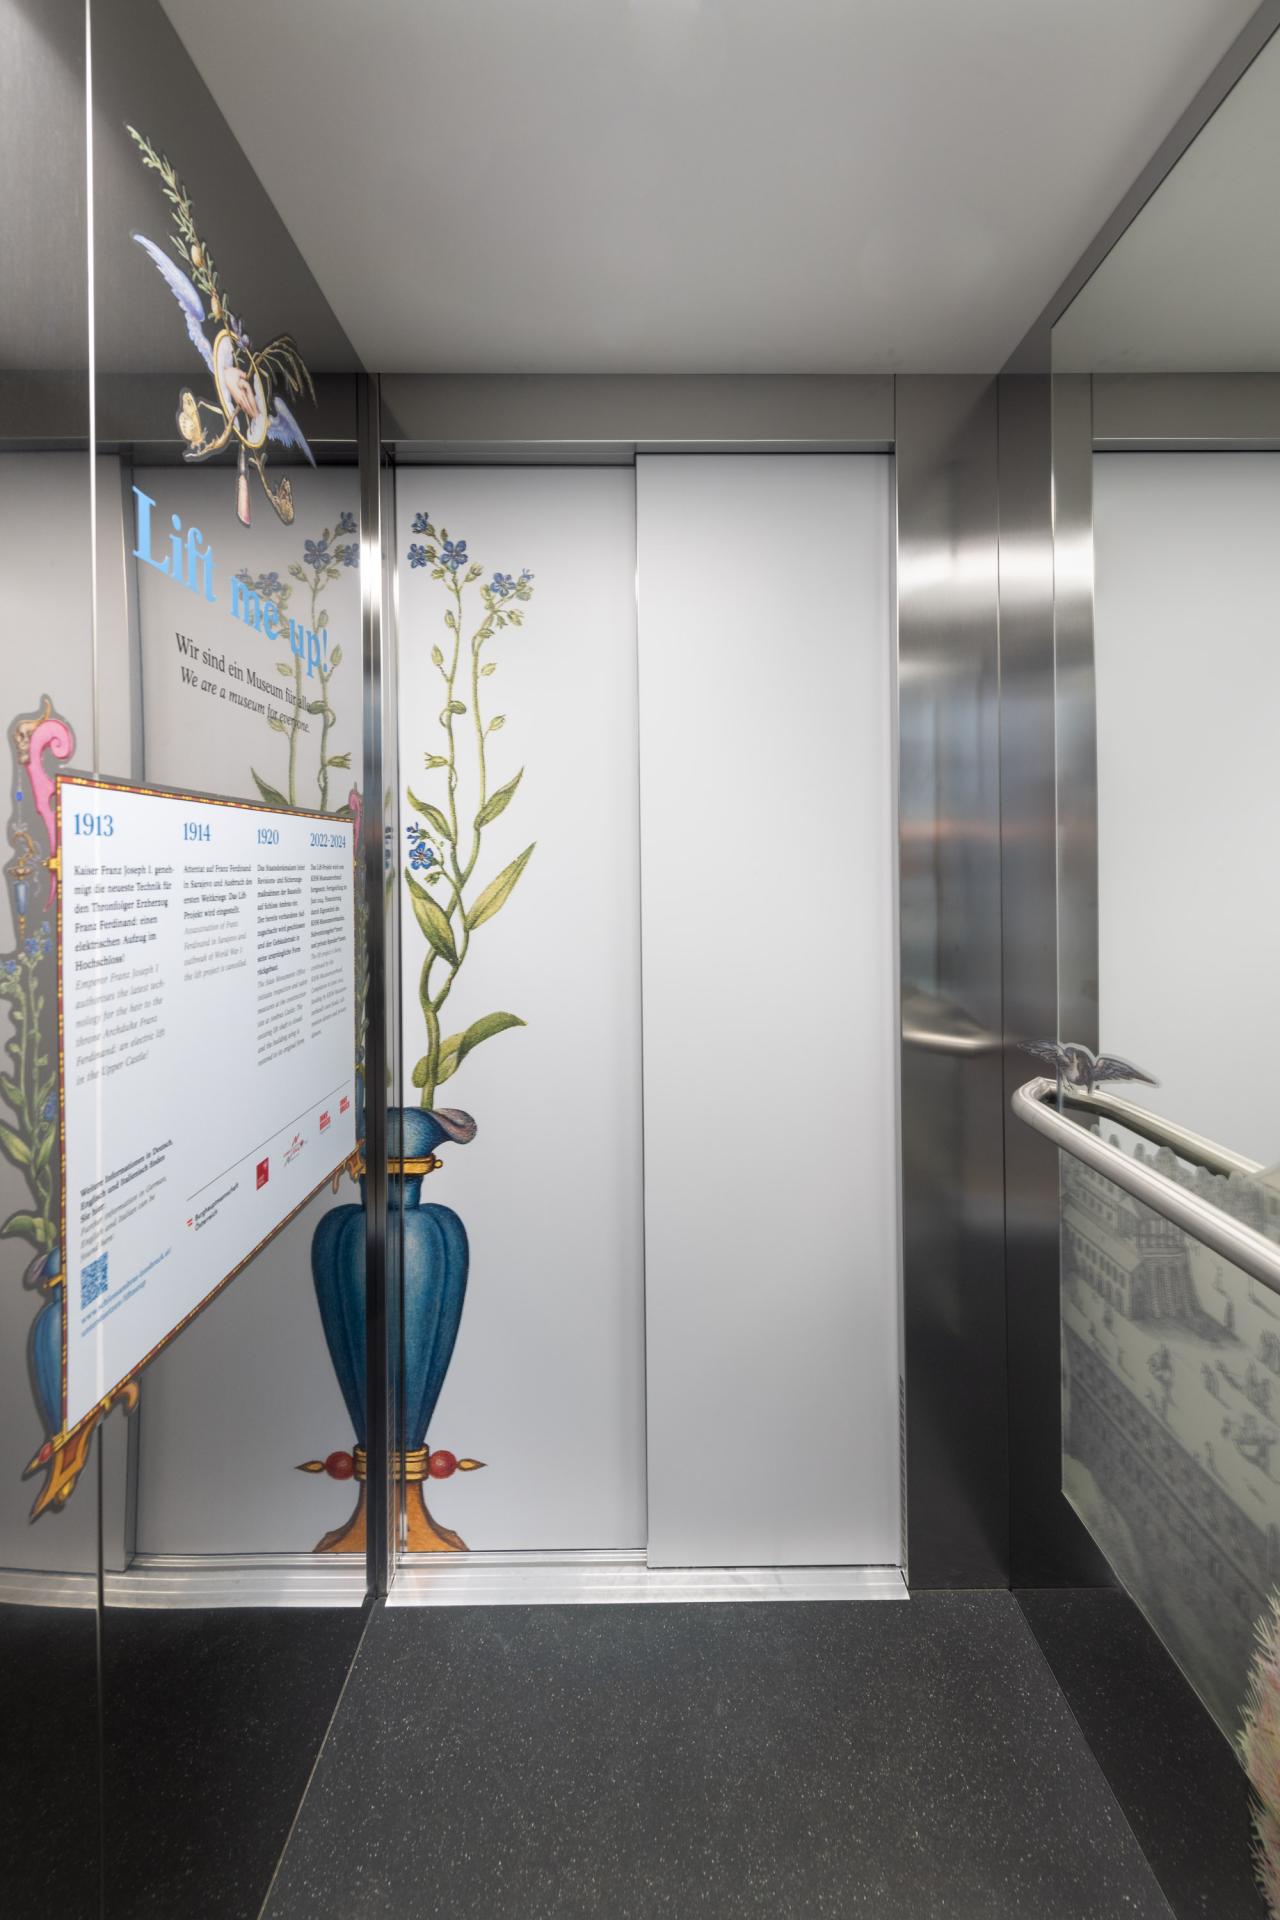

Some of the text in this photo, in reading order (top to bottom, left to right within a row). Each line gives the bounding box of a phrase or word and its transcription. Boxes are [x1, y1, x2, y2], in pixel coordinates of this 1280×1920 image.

[132, 485, 328, 679] Lift me up!
[175, 632, 199, 660] Wir
[202, 648, 225, 673] sind
[228, 661, 244, 682] ein
[246, 668, 284, 700] Museum
[285, 687, 296, 705] für
[181, 666, 198, 687] We
[201, 678, 217, 696] are
[219, 687, 226, 699] a
[229, 690, 265, 715] museum
[267, 703, 278, 719] for
[74, 813, 114, 837] 1913
[184, 822, 211, 841] 1914
[257, 828, 279, 845] 1920
[310, 832, 346, 848] 2022-2024
[101, 866, 122, 875] Franz
[124, 865, 146, 876] Joseph
[74, 922, 97, 933] Franz
